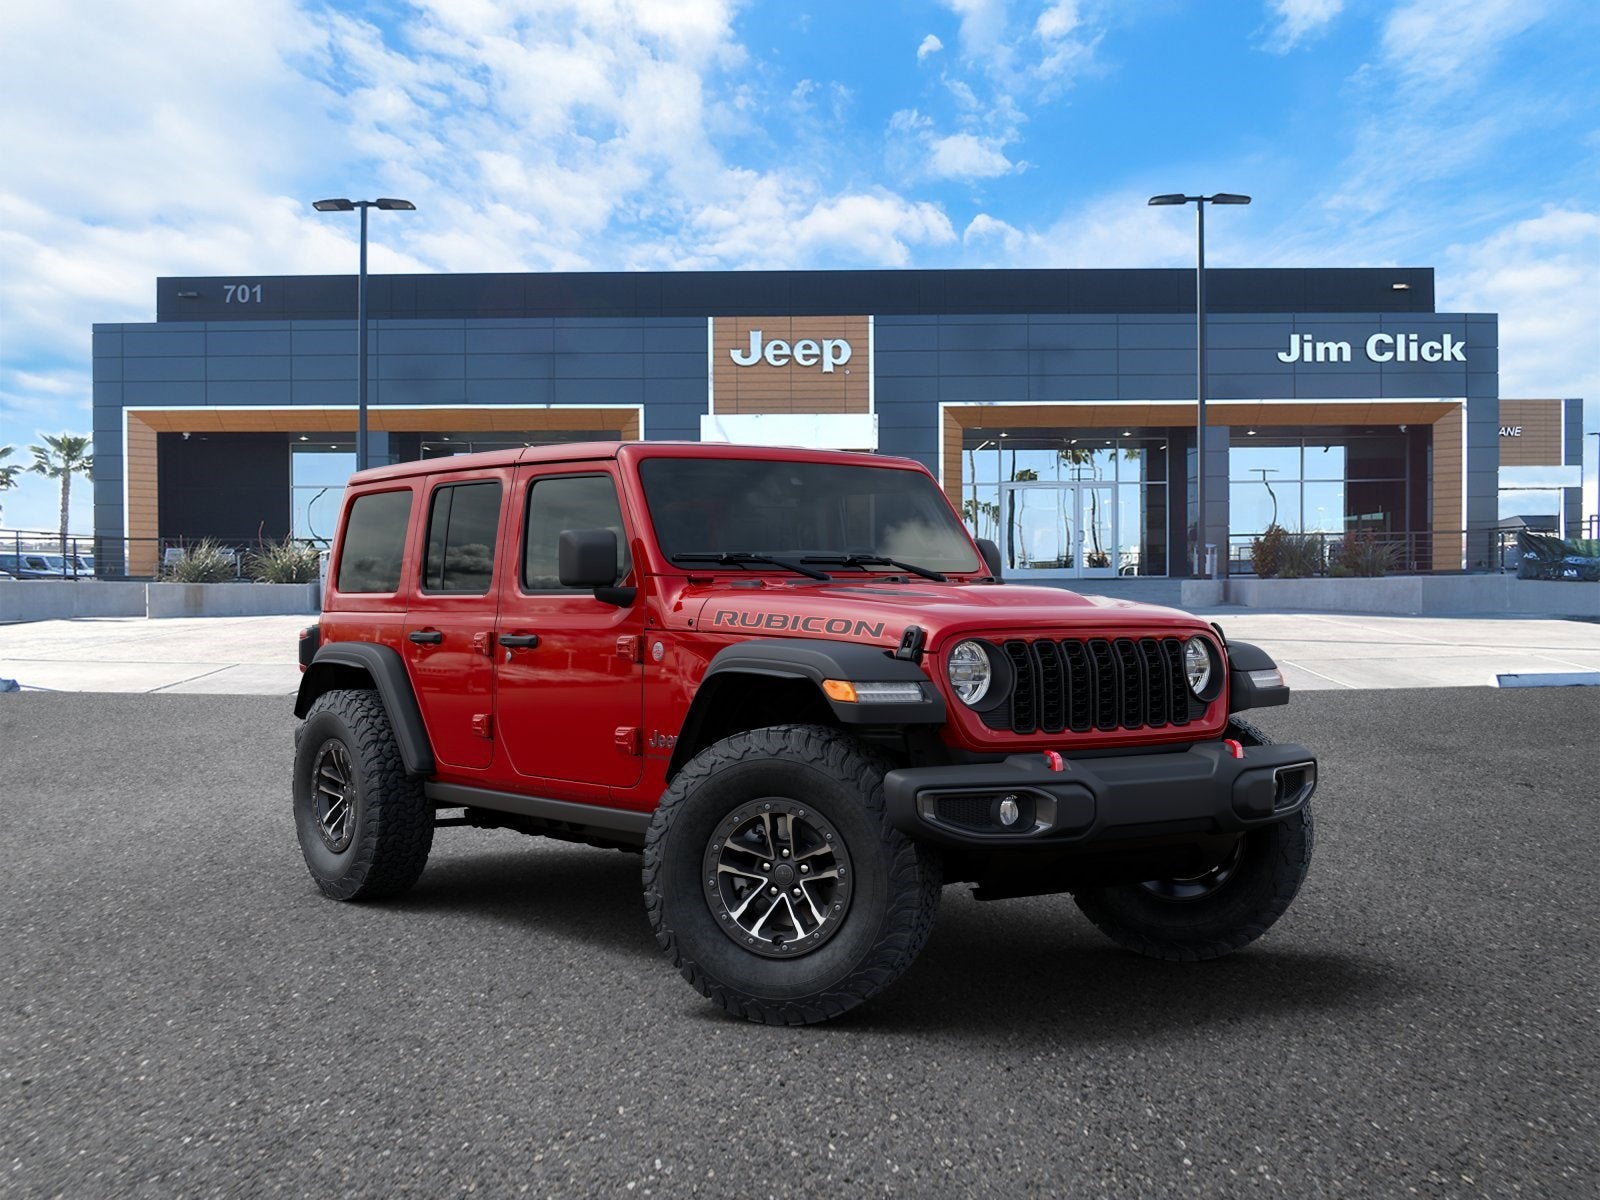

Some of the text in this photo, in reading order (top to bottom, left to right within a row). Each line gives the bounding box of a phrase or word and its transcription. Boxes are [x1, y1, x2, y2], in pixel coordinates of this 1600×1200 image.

[223, 284, 261, 303] 701
[730, 330, 852, 373] Jeep
[1277, 333, 1467, 362] Jim Click
[713, 610, 886, 638] RUBICON
